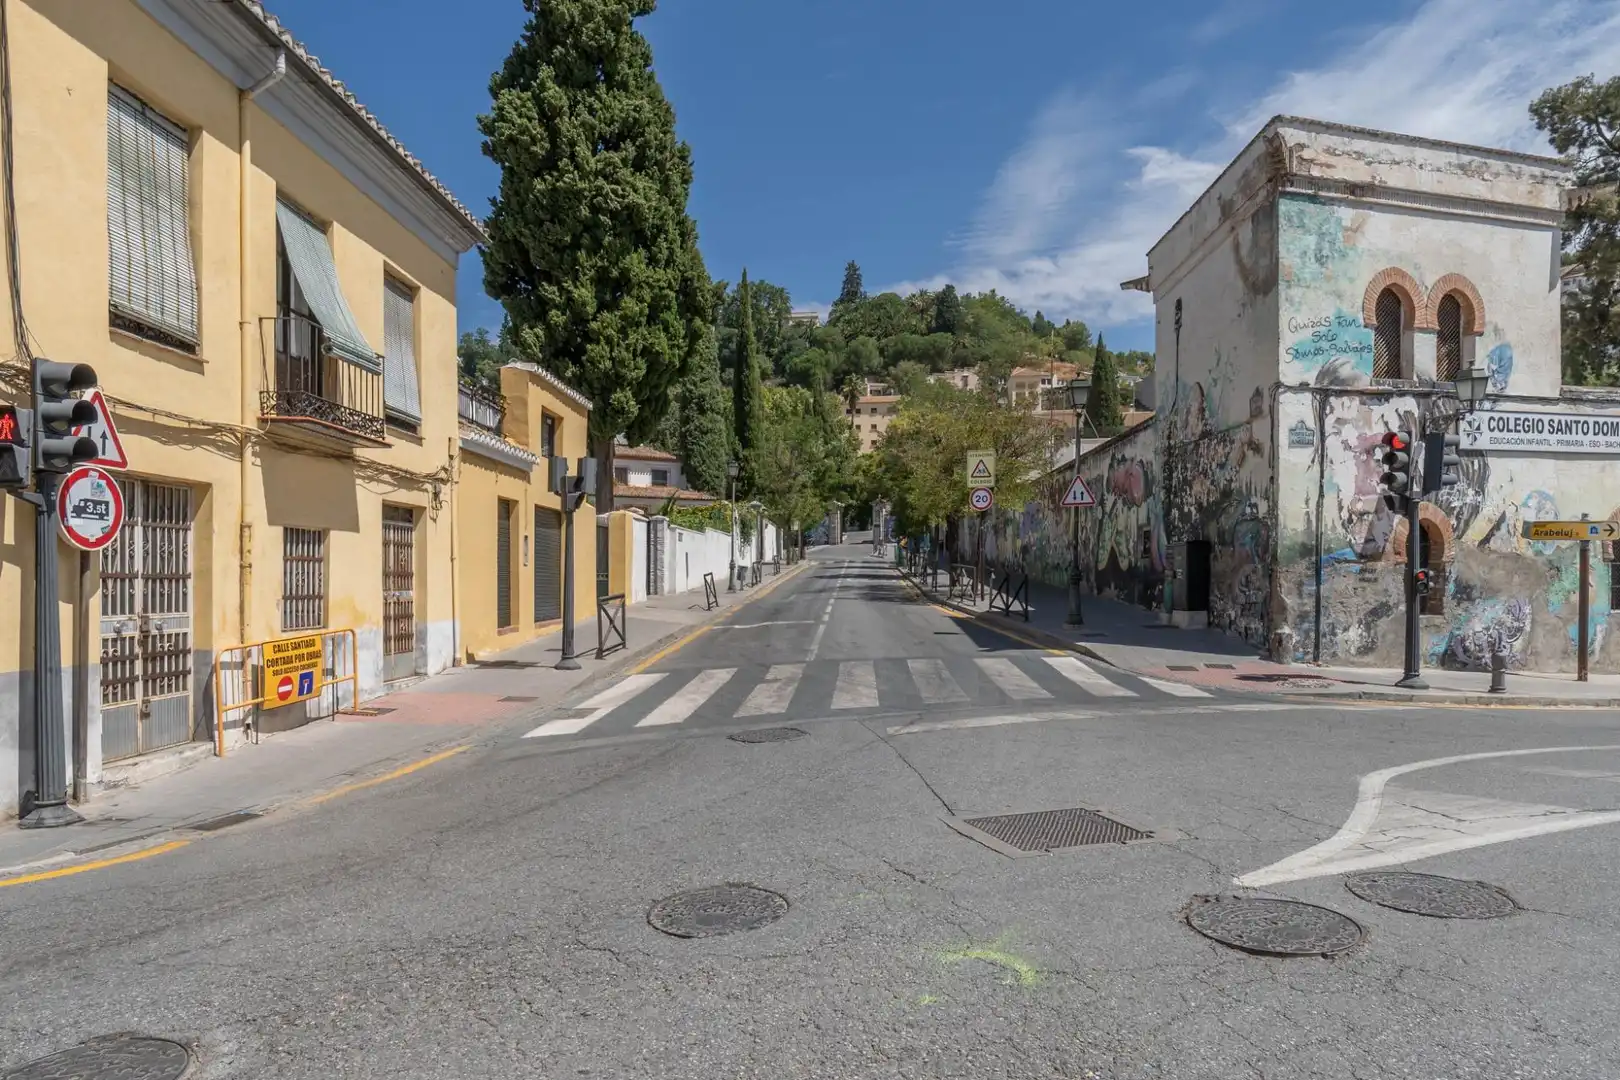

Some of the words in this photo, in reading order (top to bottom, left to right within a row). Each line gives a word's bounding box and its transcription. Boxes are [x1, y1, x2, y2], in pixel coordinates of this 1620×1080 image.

[1487, 415, 1545, 434] COLEGIO
[1547, 418, 1590, 436] SANTO
[1592, 420, 1620, 437] DOM
[1525, 437, 1552, 447] INFANTIL
[1556, 438, 1584, 447] PRIMARIA
[1588, 440, 1601, 448] ESO
[975, 494, 989, 503] 20
[272, 643, 290, 654] CALLE
[290, 638, 316, 651] SANTIAGO
[266, 655, 294, 669] CORTADA
[294, 652, 306, 664] POR
[306, 649, 322, 661] OBRAS
